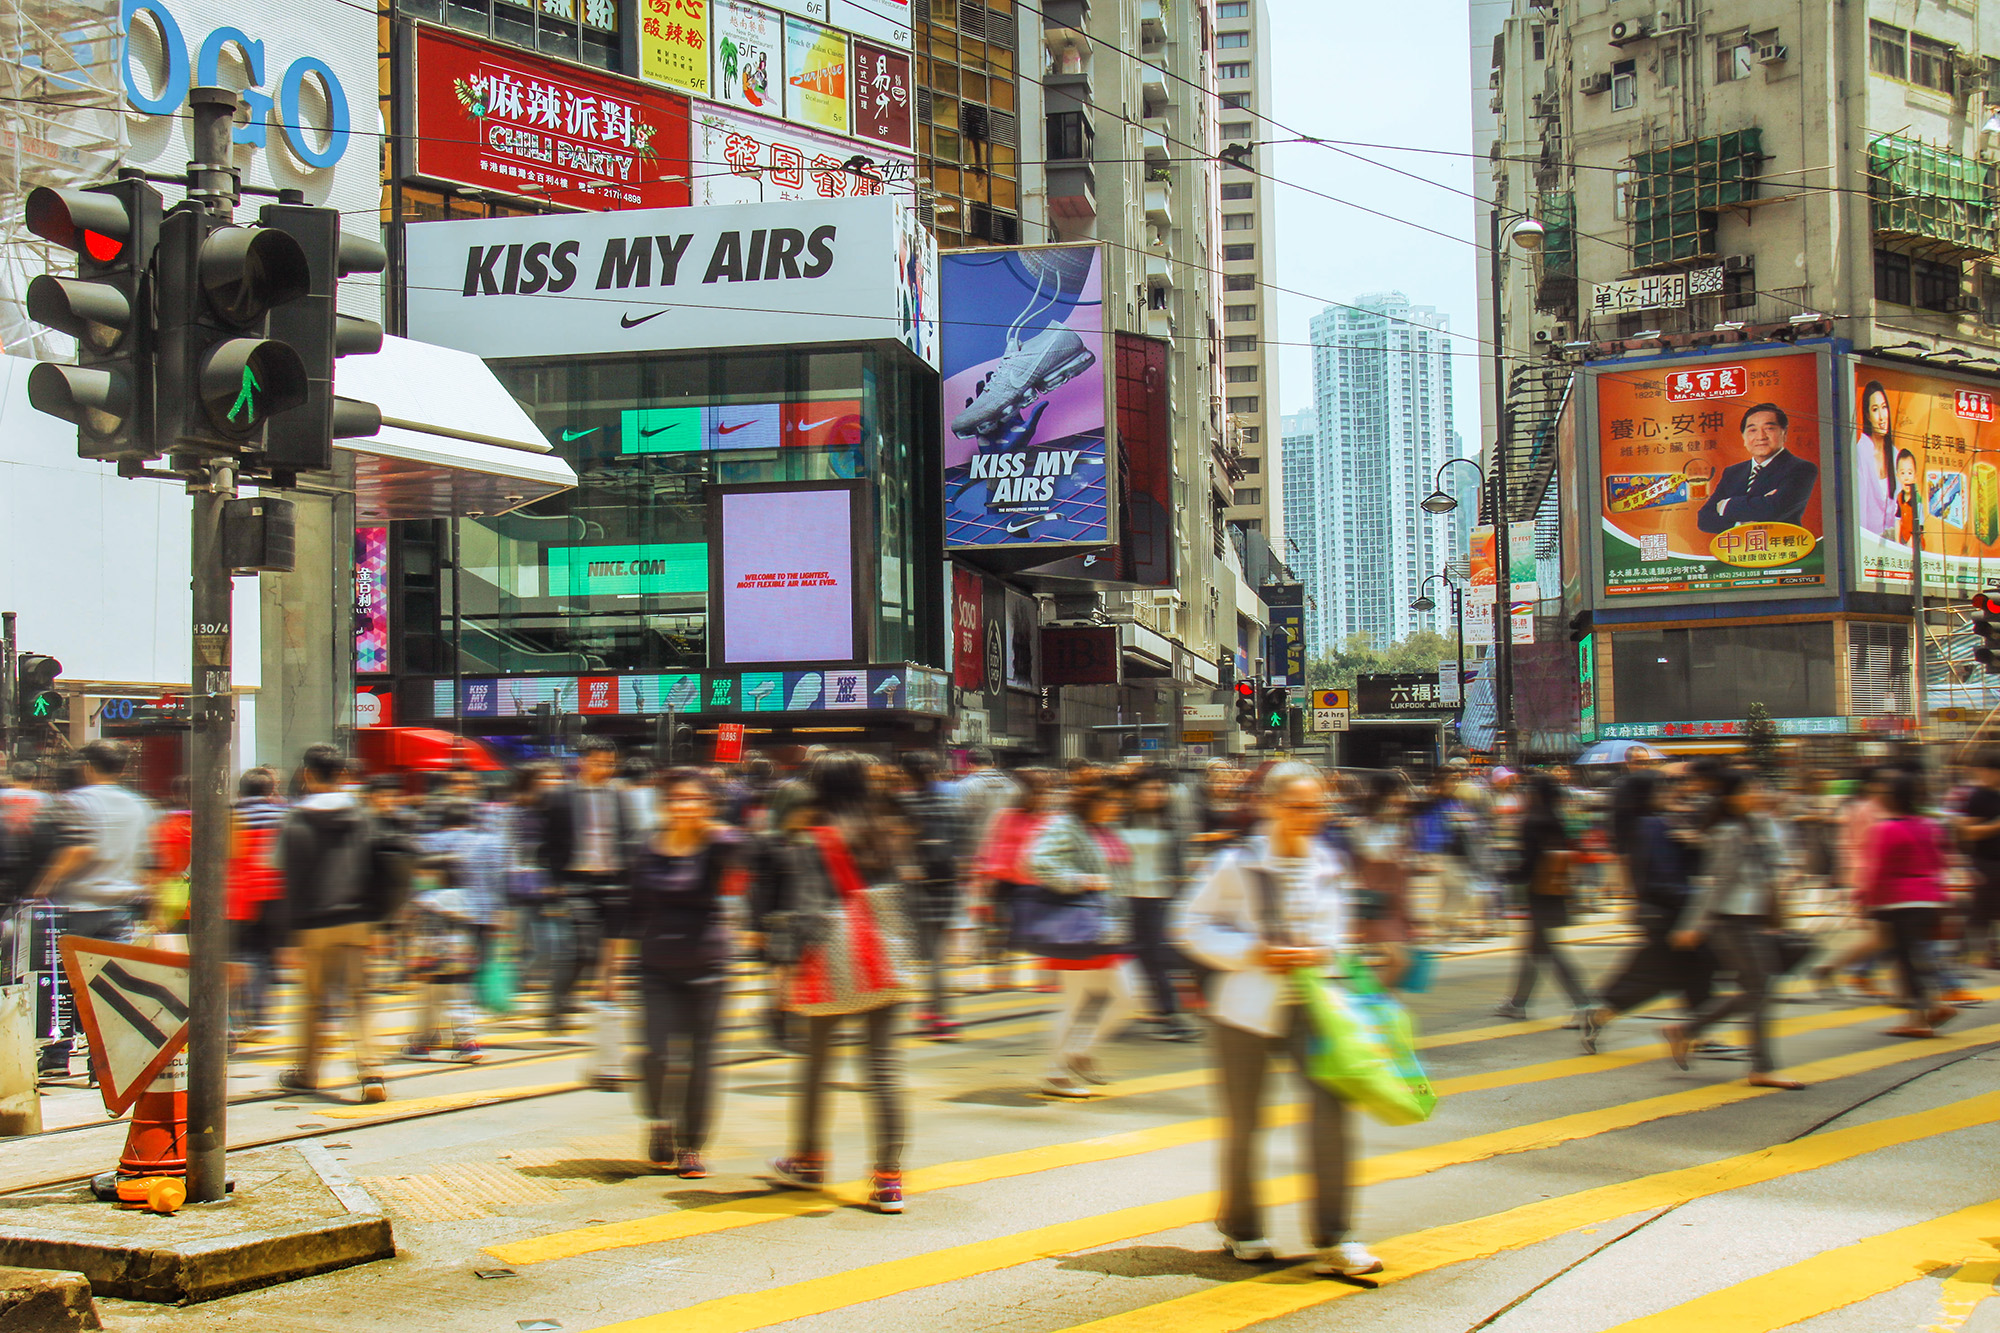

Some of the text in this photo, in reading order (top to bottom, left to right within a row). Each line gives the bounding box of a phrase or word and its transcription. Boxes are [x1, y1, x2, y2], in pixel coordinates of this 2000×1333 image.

[806, 2, 822, 14] 6/F
[644, 18, 705, 50] 酸辣粉
[893, 29, 908, 42] 6/F
[739, 42, 758, 58] 5/F
[690, 78, 706, 89] 5/F
[487, 73, 634, 148] 麻辣派對
[878, 125, 889, 136] 5F
[489, 125, 633, 180] CHILI PARTY
[623, 193, 642, 205] 4898
[463, 224, 837, 297] KISS MY AIRS
[1750, 369, 1780, 380] SINCE
[1674, 370, 1737, 394] 馬百良
[969, 450, 1081, 479] KISS MY
[992, 476, 1055, 503] AIRS
[588, 559, 665, 577] NIKE.COM
[745, 573, 776, 581] WELCOME
[800, 571, 830, 580] LIGHTEST,
[357, 567, 373, 607] 金百利
[757, 580, 786, 588] FLEXIBLE
[1286, 617, 1300, 676] IKEA
[589, 682, 609, 691] KISS
[712, 679, 732, 688] KISS
[837, 677, 857, 686] KISS
[469, 685, 488, 694] KISS
[713, 688, 730, 697] MY
[838, 685, 855, 694] MY
[470, 693, 487, 703] MY
[591, 691, 605, 700] MY
[710, 697, 732, 705] AIRS
[835, 694, 857, 703] AIRS
[467, 702, 488, 711] AIRS
[588, 699, 608, 708] AIRS
[1428, 701, 1460, 709] JEWELLE
[1320, 720, 1341, 729] 全日
